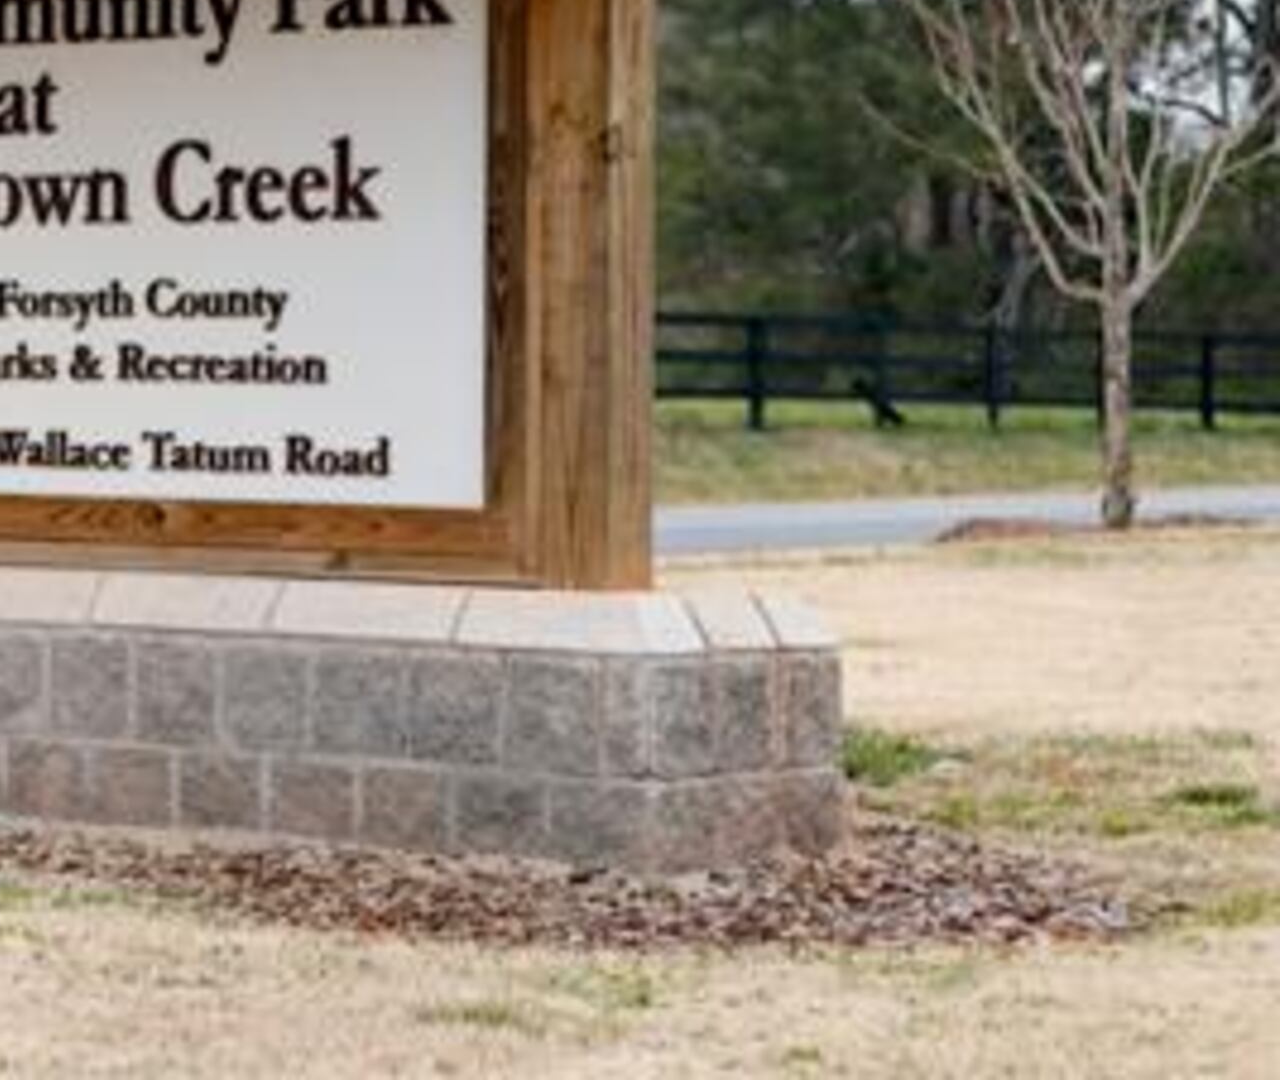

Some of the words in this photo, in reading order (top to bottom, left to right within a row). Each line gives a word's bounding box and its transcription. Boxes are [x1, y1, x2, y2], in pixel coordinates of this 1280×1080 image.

[154, 134, 382, 226] Creek
[144, 278, 289, 332] County
[68, 343, 105, 383] &
[116, 342, 328, 386] Recreation
[141, 430, 272, 475] Tatum
[284, 434, 391, 479] Road
